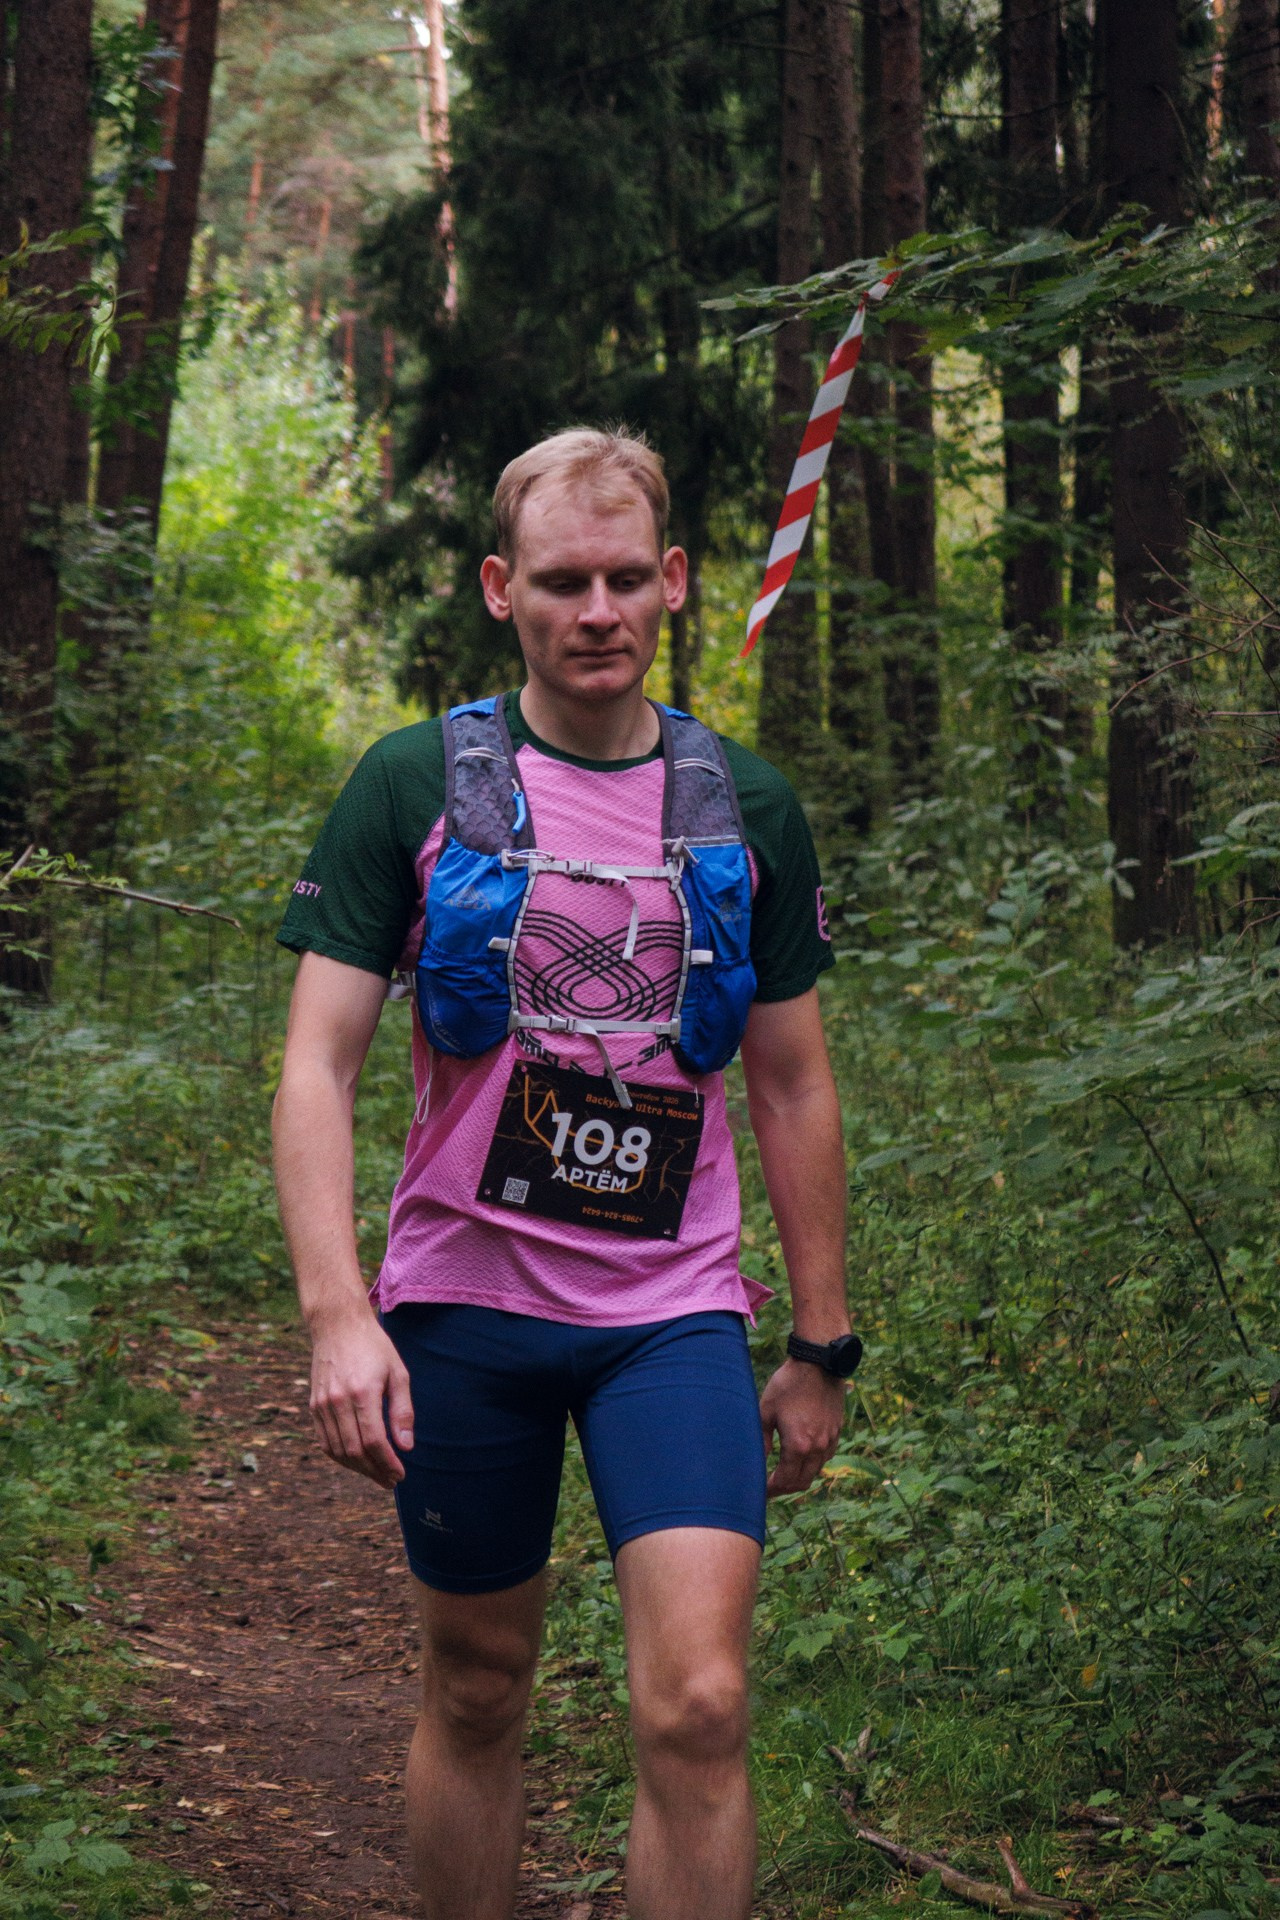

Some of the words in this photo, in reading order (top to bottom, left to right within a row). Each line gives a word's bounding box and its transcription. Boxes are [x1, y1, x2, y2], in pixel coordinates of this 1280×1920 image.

[585, 1093, 624, 1109] Backya
[635, 1102, 663, 1116] Ultra
[666, 1108, 699, 1121] Moscow
[551, 1112, 652, 1173] 108
[551, 1164, 629, 1194] АРТЁМ
